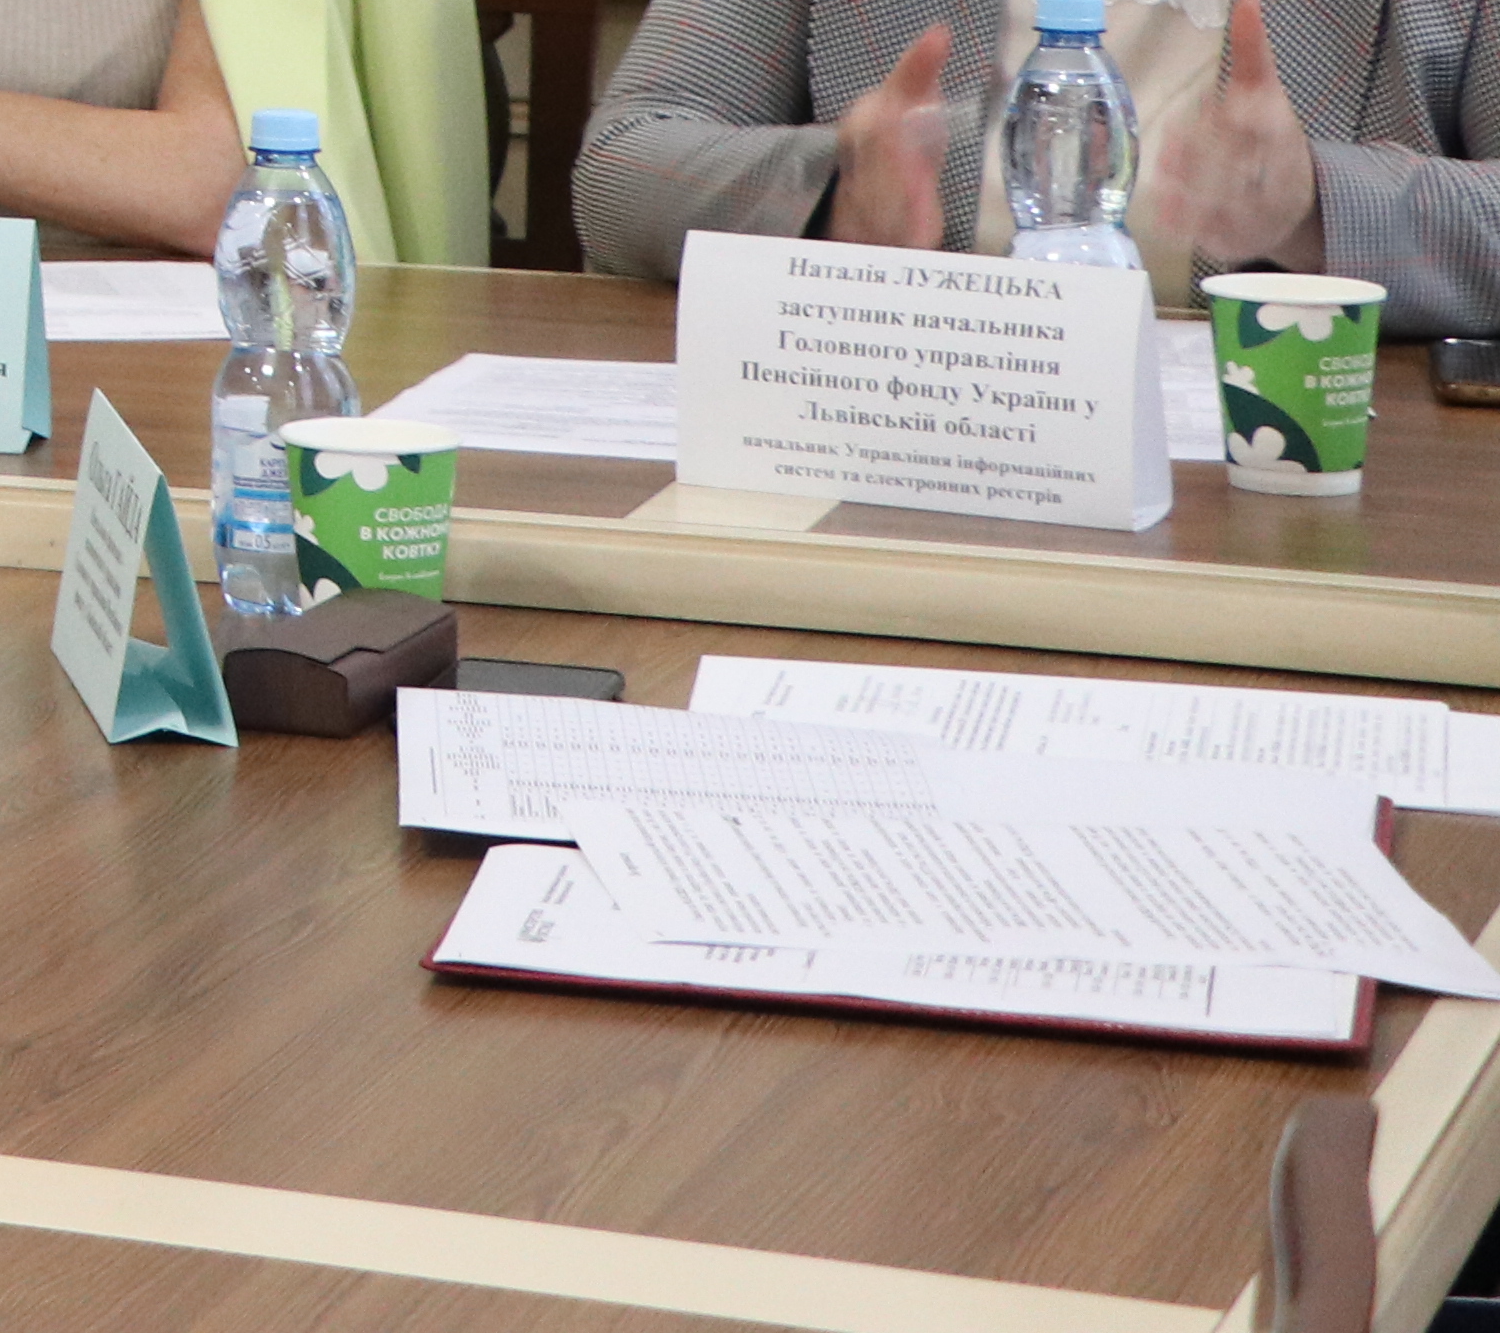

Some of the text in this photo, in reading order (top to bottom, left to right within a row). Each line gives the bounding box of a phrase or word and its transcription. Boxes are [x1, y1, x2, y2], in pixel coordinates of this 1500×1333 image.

[788, 257, 1063, 301] Наталія ЛУЖЕЦЬКА
[777, 300, 1065, 342] заступник начальника
[778, 330, 1060, 376] Головного управління
[741, 360, 1099, 417] Пенсійного фонду України у
[798, 401, 1036, 444] Львівській області
[743, 435, 838, 456] начальник
[845, 443, 951, 468] Управління
[841, 471, 860, 482] та
